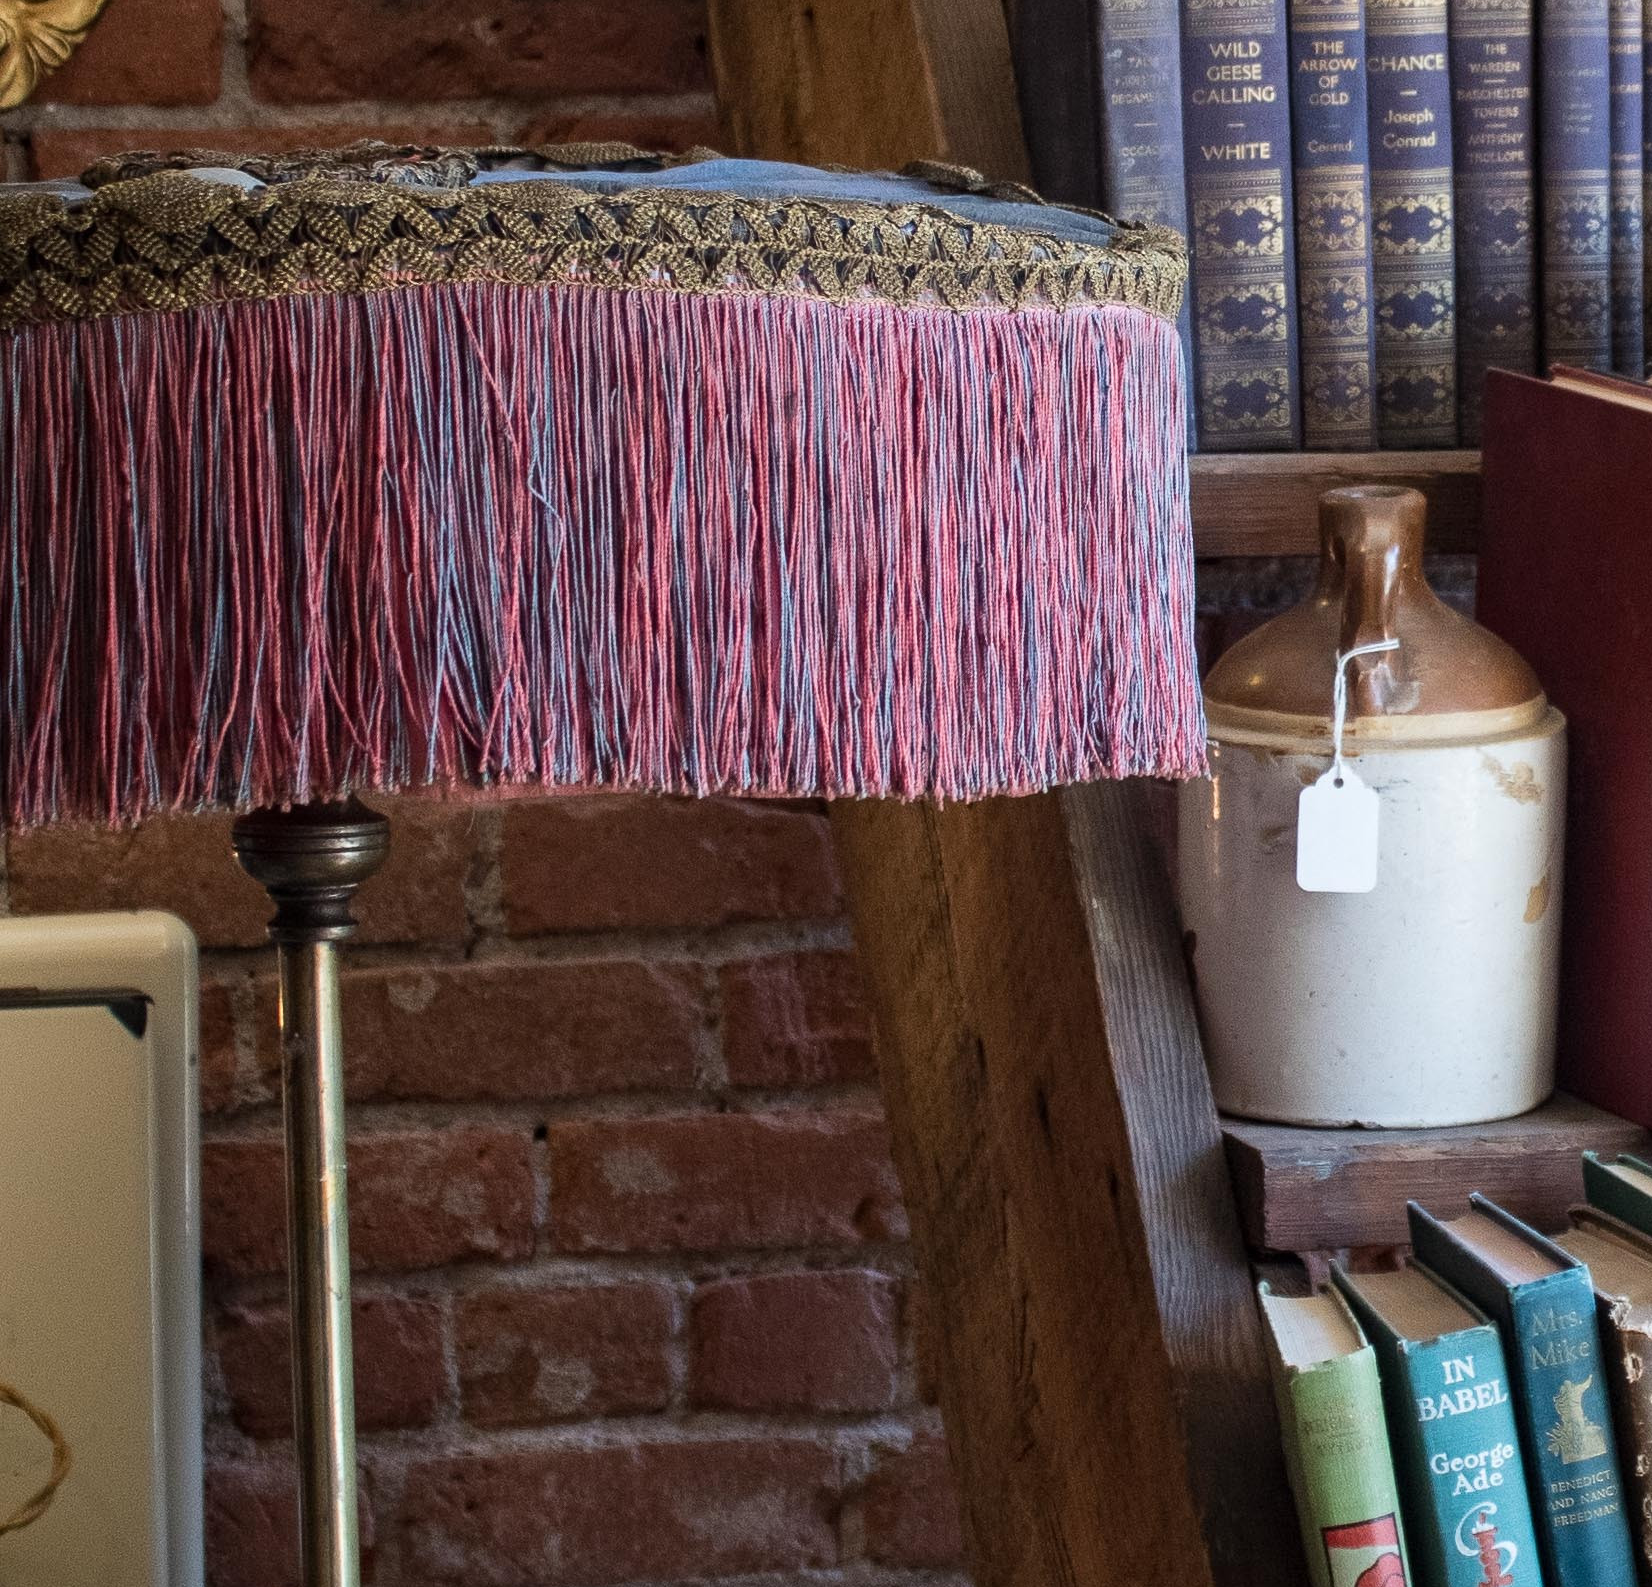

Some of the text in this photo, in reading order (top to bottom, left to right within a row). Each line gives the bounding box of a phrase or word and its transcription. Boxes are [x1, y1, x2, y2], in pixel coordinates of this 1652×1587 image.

[1210, 42, 1260, 59] WILD
[1312, 41, 1344, 54] THE
[1484, 43, 1507, 54] THE
[1299, 59, 1357, 71] ARROW
[1367, 54, 1444, 71] CHANCE
[1207, 64, 1262, 81] GEESE
[1319, 75, 1339, 88] OF
[1192, 86, 1275, 104] CALLING
[1309, 93, 1348, 105] GOLD
[1384, 108, 1434, 125] Joseph
[1383, 132, 1436, 148] Conrad
[1201, 142, 1271, 160] WHITE
[1532, 1309, 1582, 1336] Mrs.
[1531, 1341, 1590, 1370] Mike
[1442, 1355, 1475, 1385] IN
[1416, 1380, 1508, 1421] BABEL
[1431, 1443, 1515, 1475] George
[1453, 1468, 1504, 1497] Ade
[1550, 1469, 1611, 1493] BENEDICT
